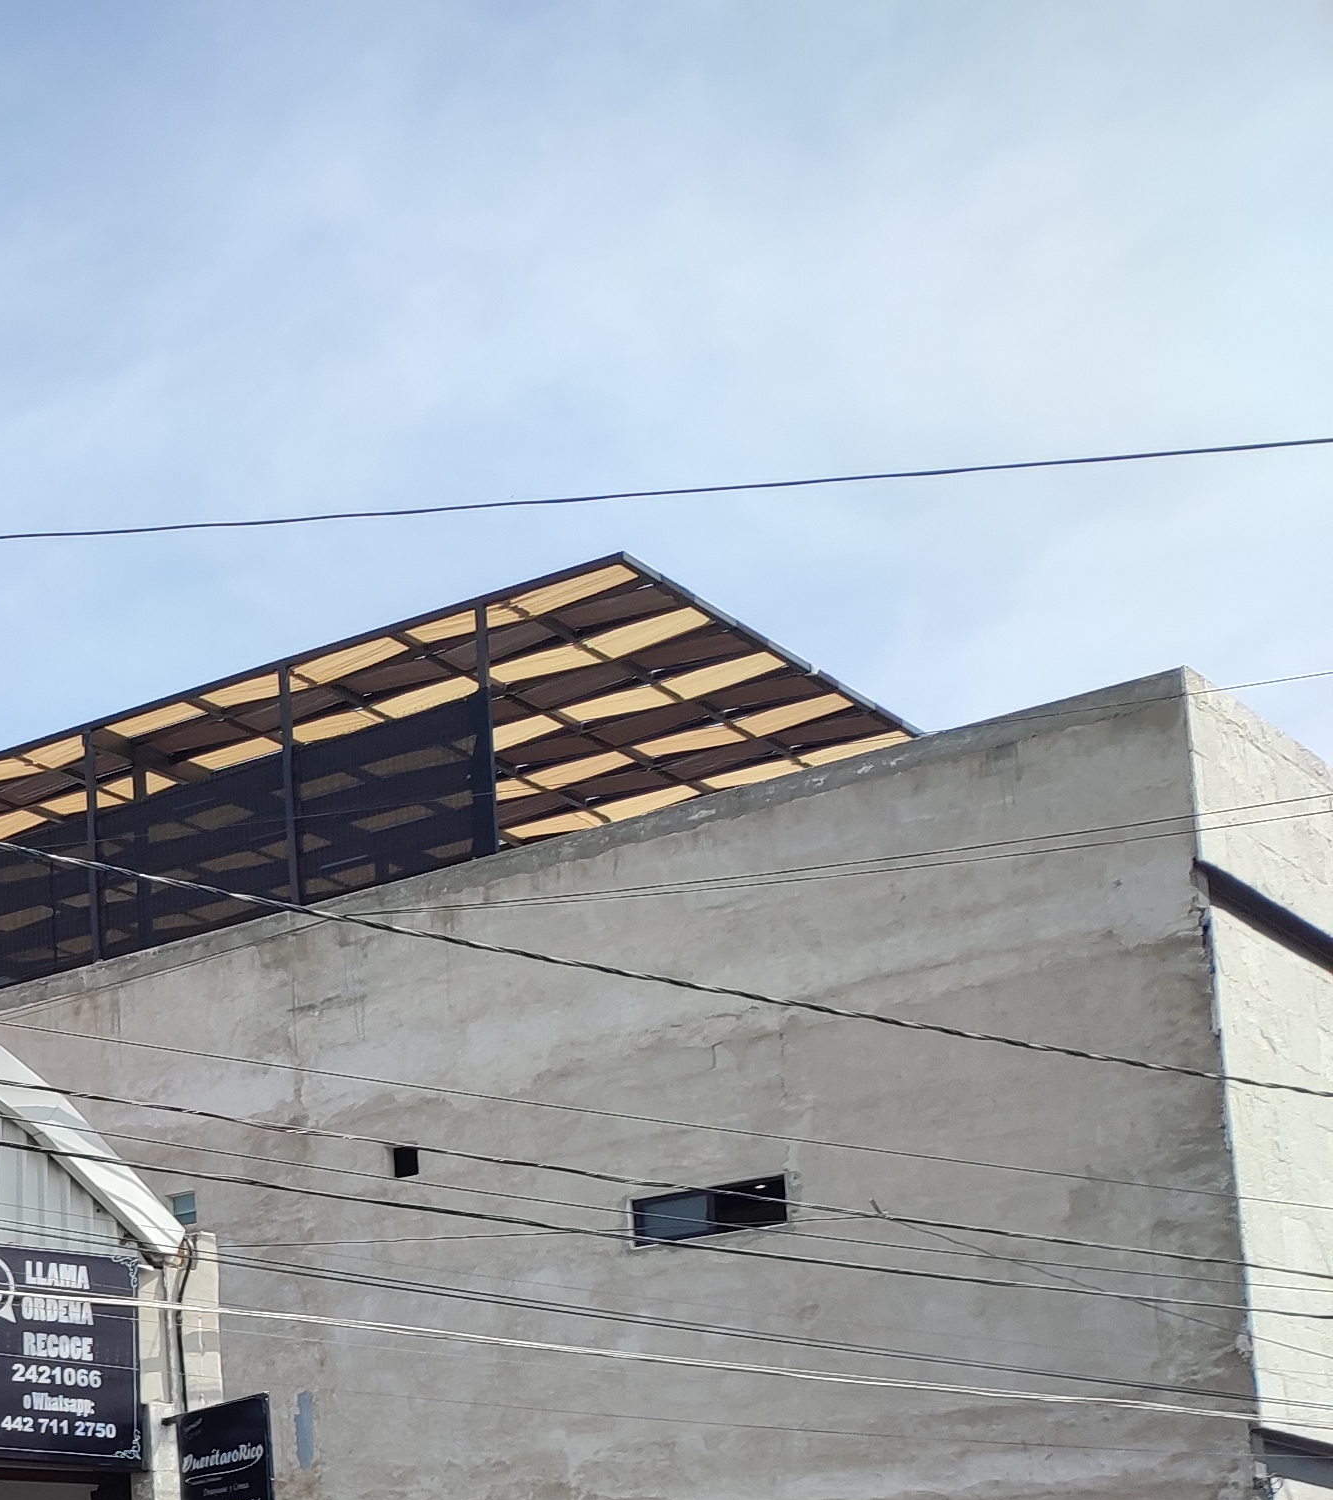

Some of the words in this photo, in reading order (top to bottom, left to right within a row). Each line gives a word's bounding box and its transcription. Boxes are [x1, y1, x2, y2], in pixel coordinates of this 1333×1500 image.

[25, 1260, 90, 1290] LLAMA
[21, 1297, 94, 1326] ORDENA
[22, 1331, 94, 1361] RECOGE
[11, 1363, 102, 1388] 2421066
[1, 1415, 35, 1432] 442
[37, 1418, 69, 1435] 711
[74, 1422, 117, 1438] 2750
